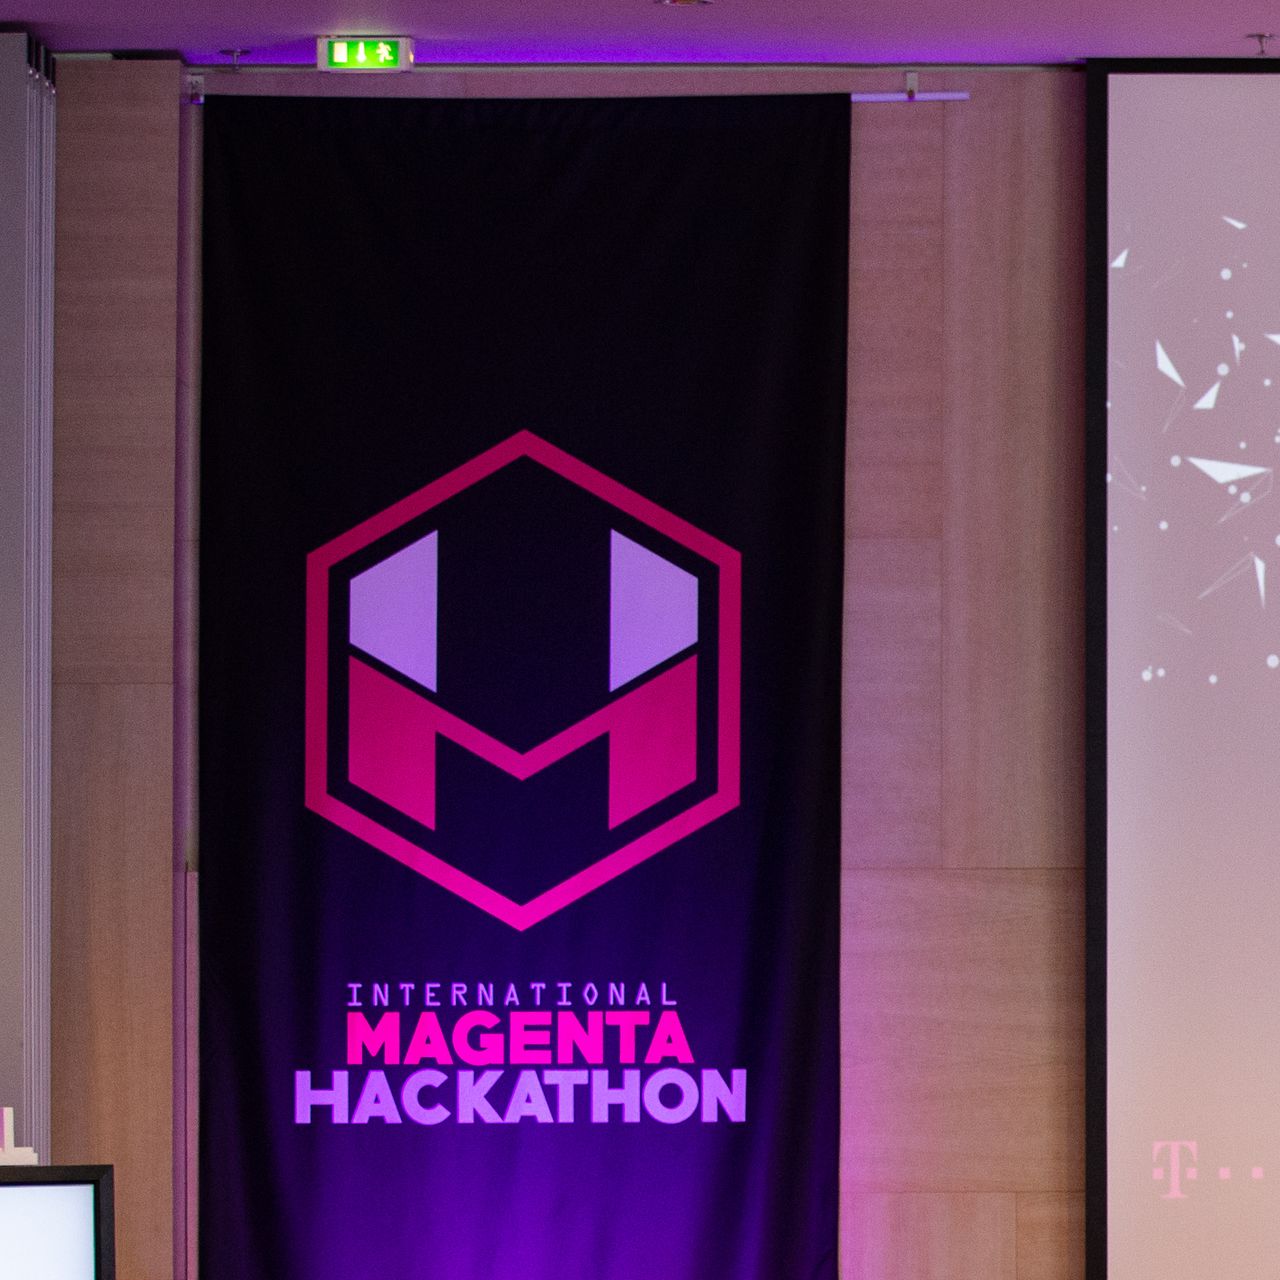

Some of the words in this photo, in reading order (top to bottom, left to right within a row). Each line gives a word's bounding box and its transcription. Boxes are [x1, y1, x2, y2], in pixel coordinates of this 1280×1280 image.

[346, 982, 677, 1007] INTERNATIONAL
[346, 1010, 695, 1066] MAGENTA
[294, 1067, 747, 1126] HACKATHON
